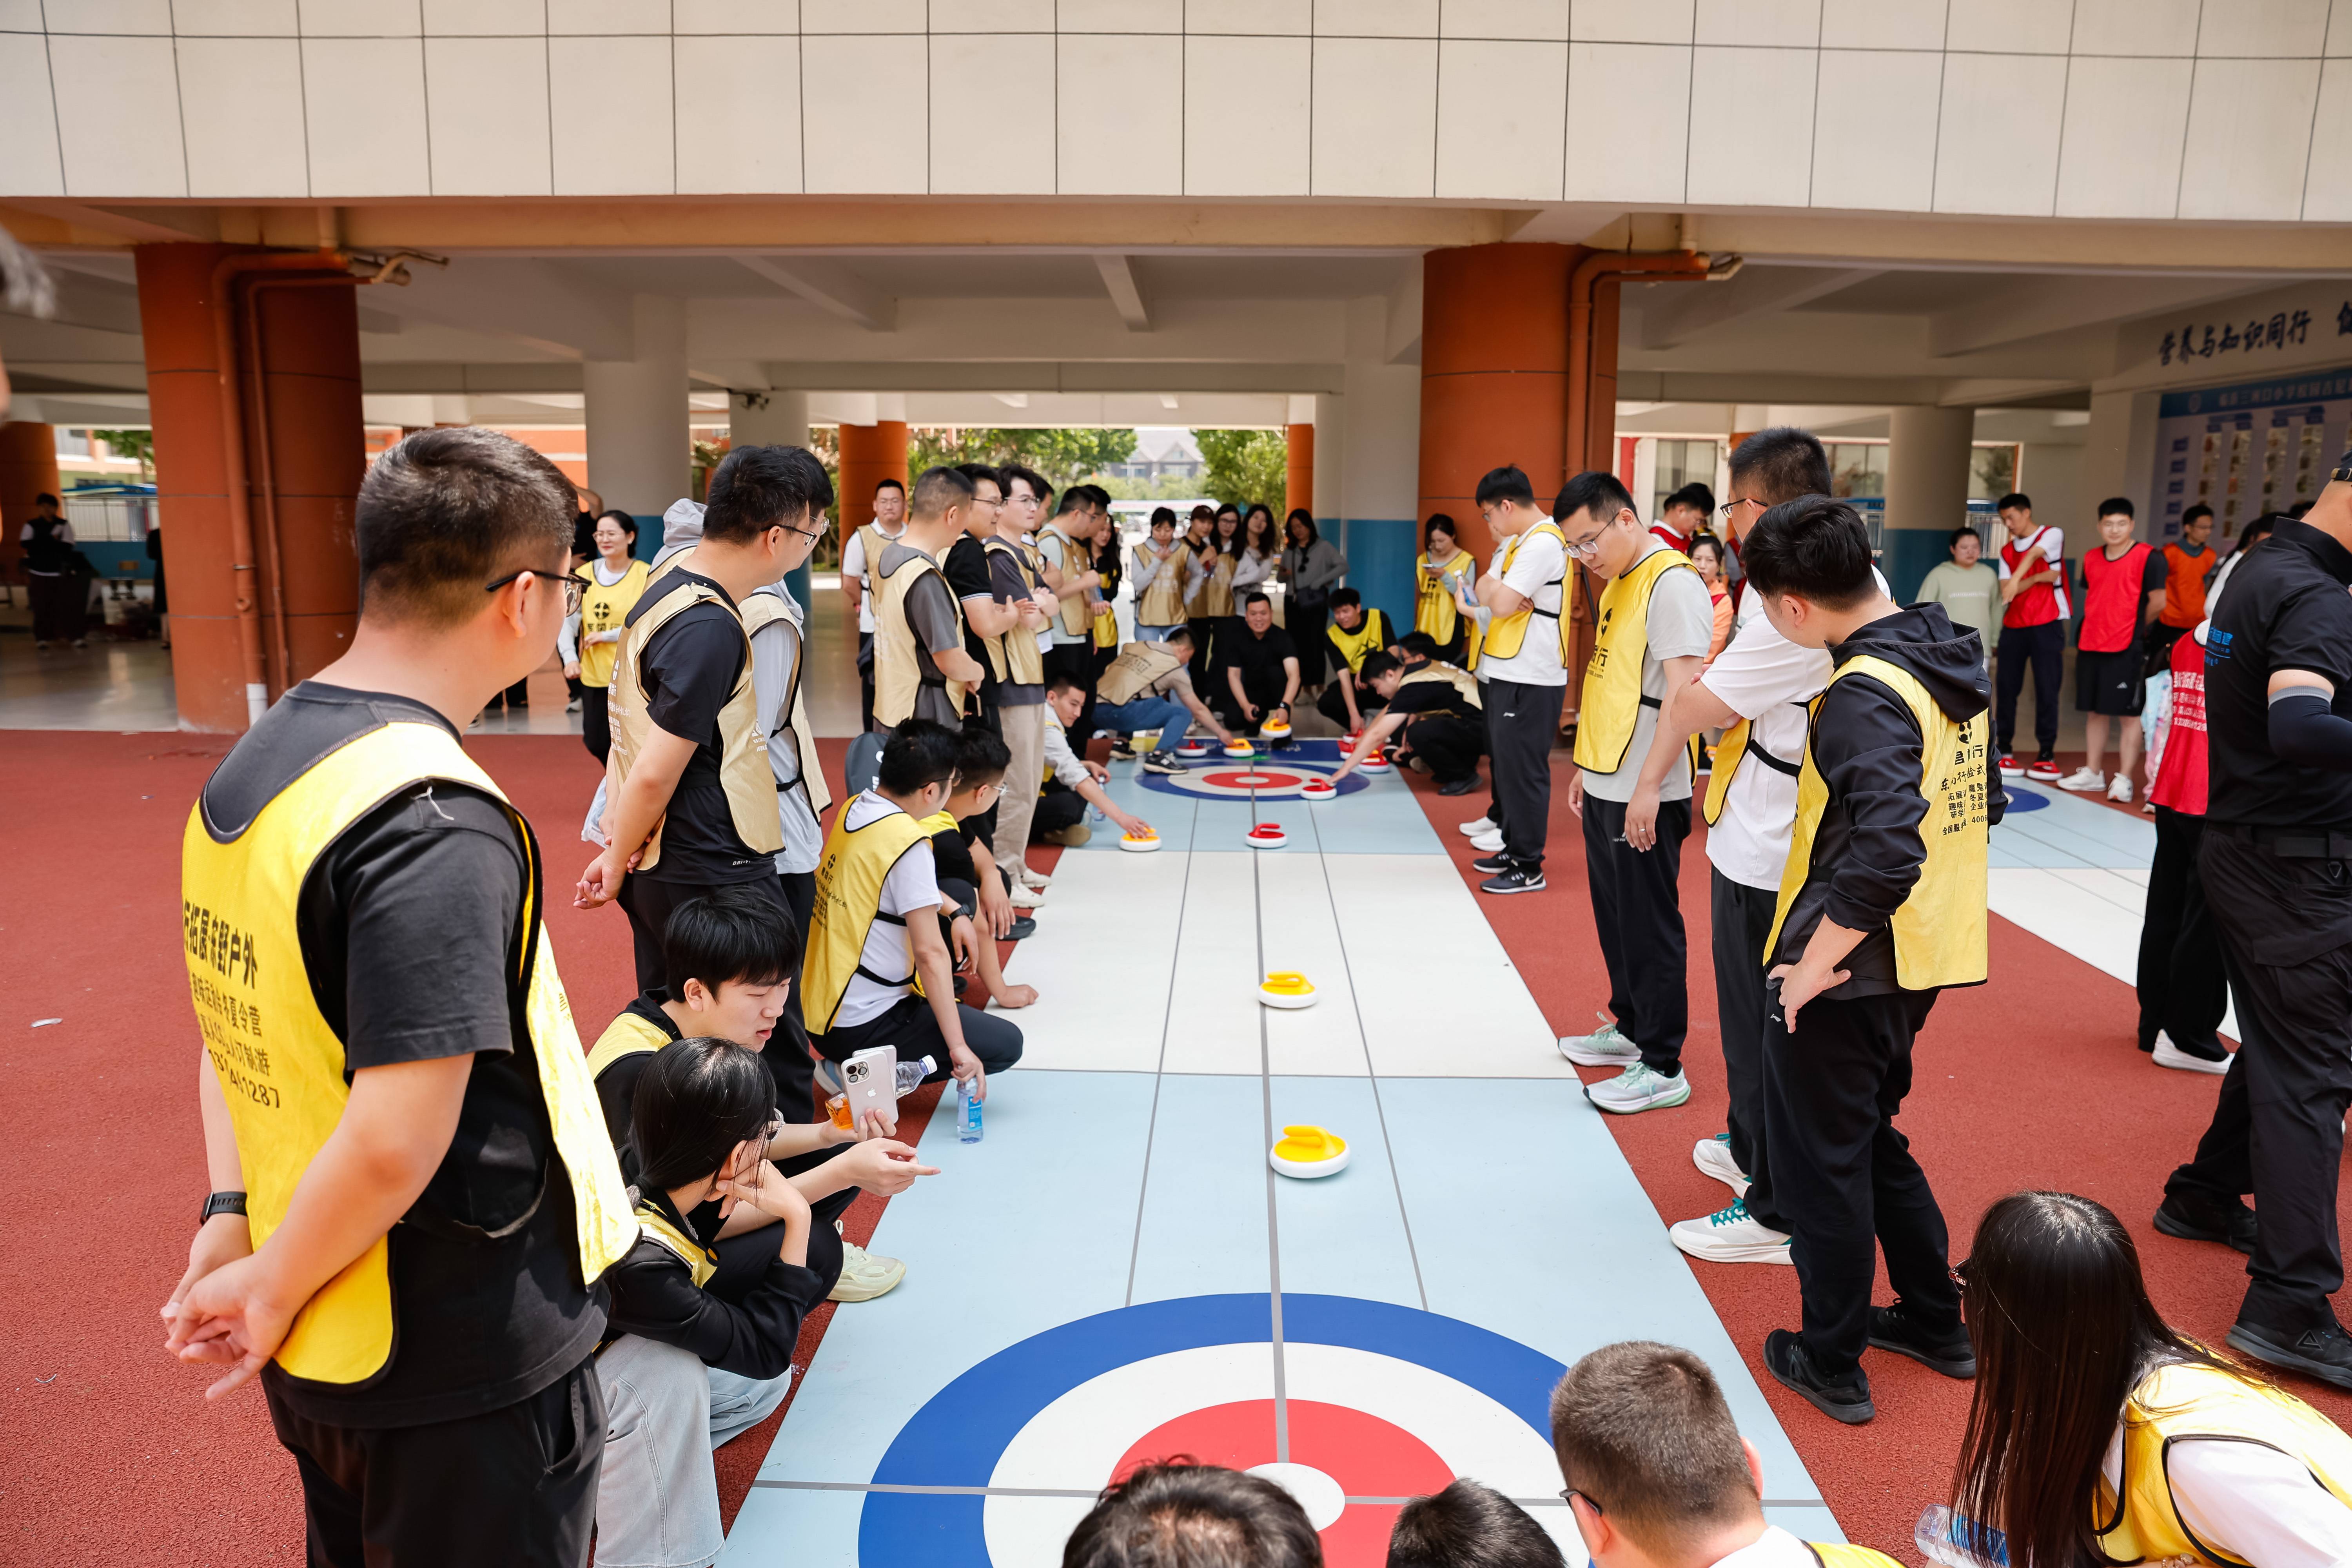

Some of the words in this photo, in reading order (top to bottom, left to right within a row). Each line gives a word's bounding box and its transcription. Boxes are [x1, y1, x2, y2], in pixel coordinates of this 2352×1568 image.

[2159, 310, 2311, 366] 营养与知识同行
